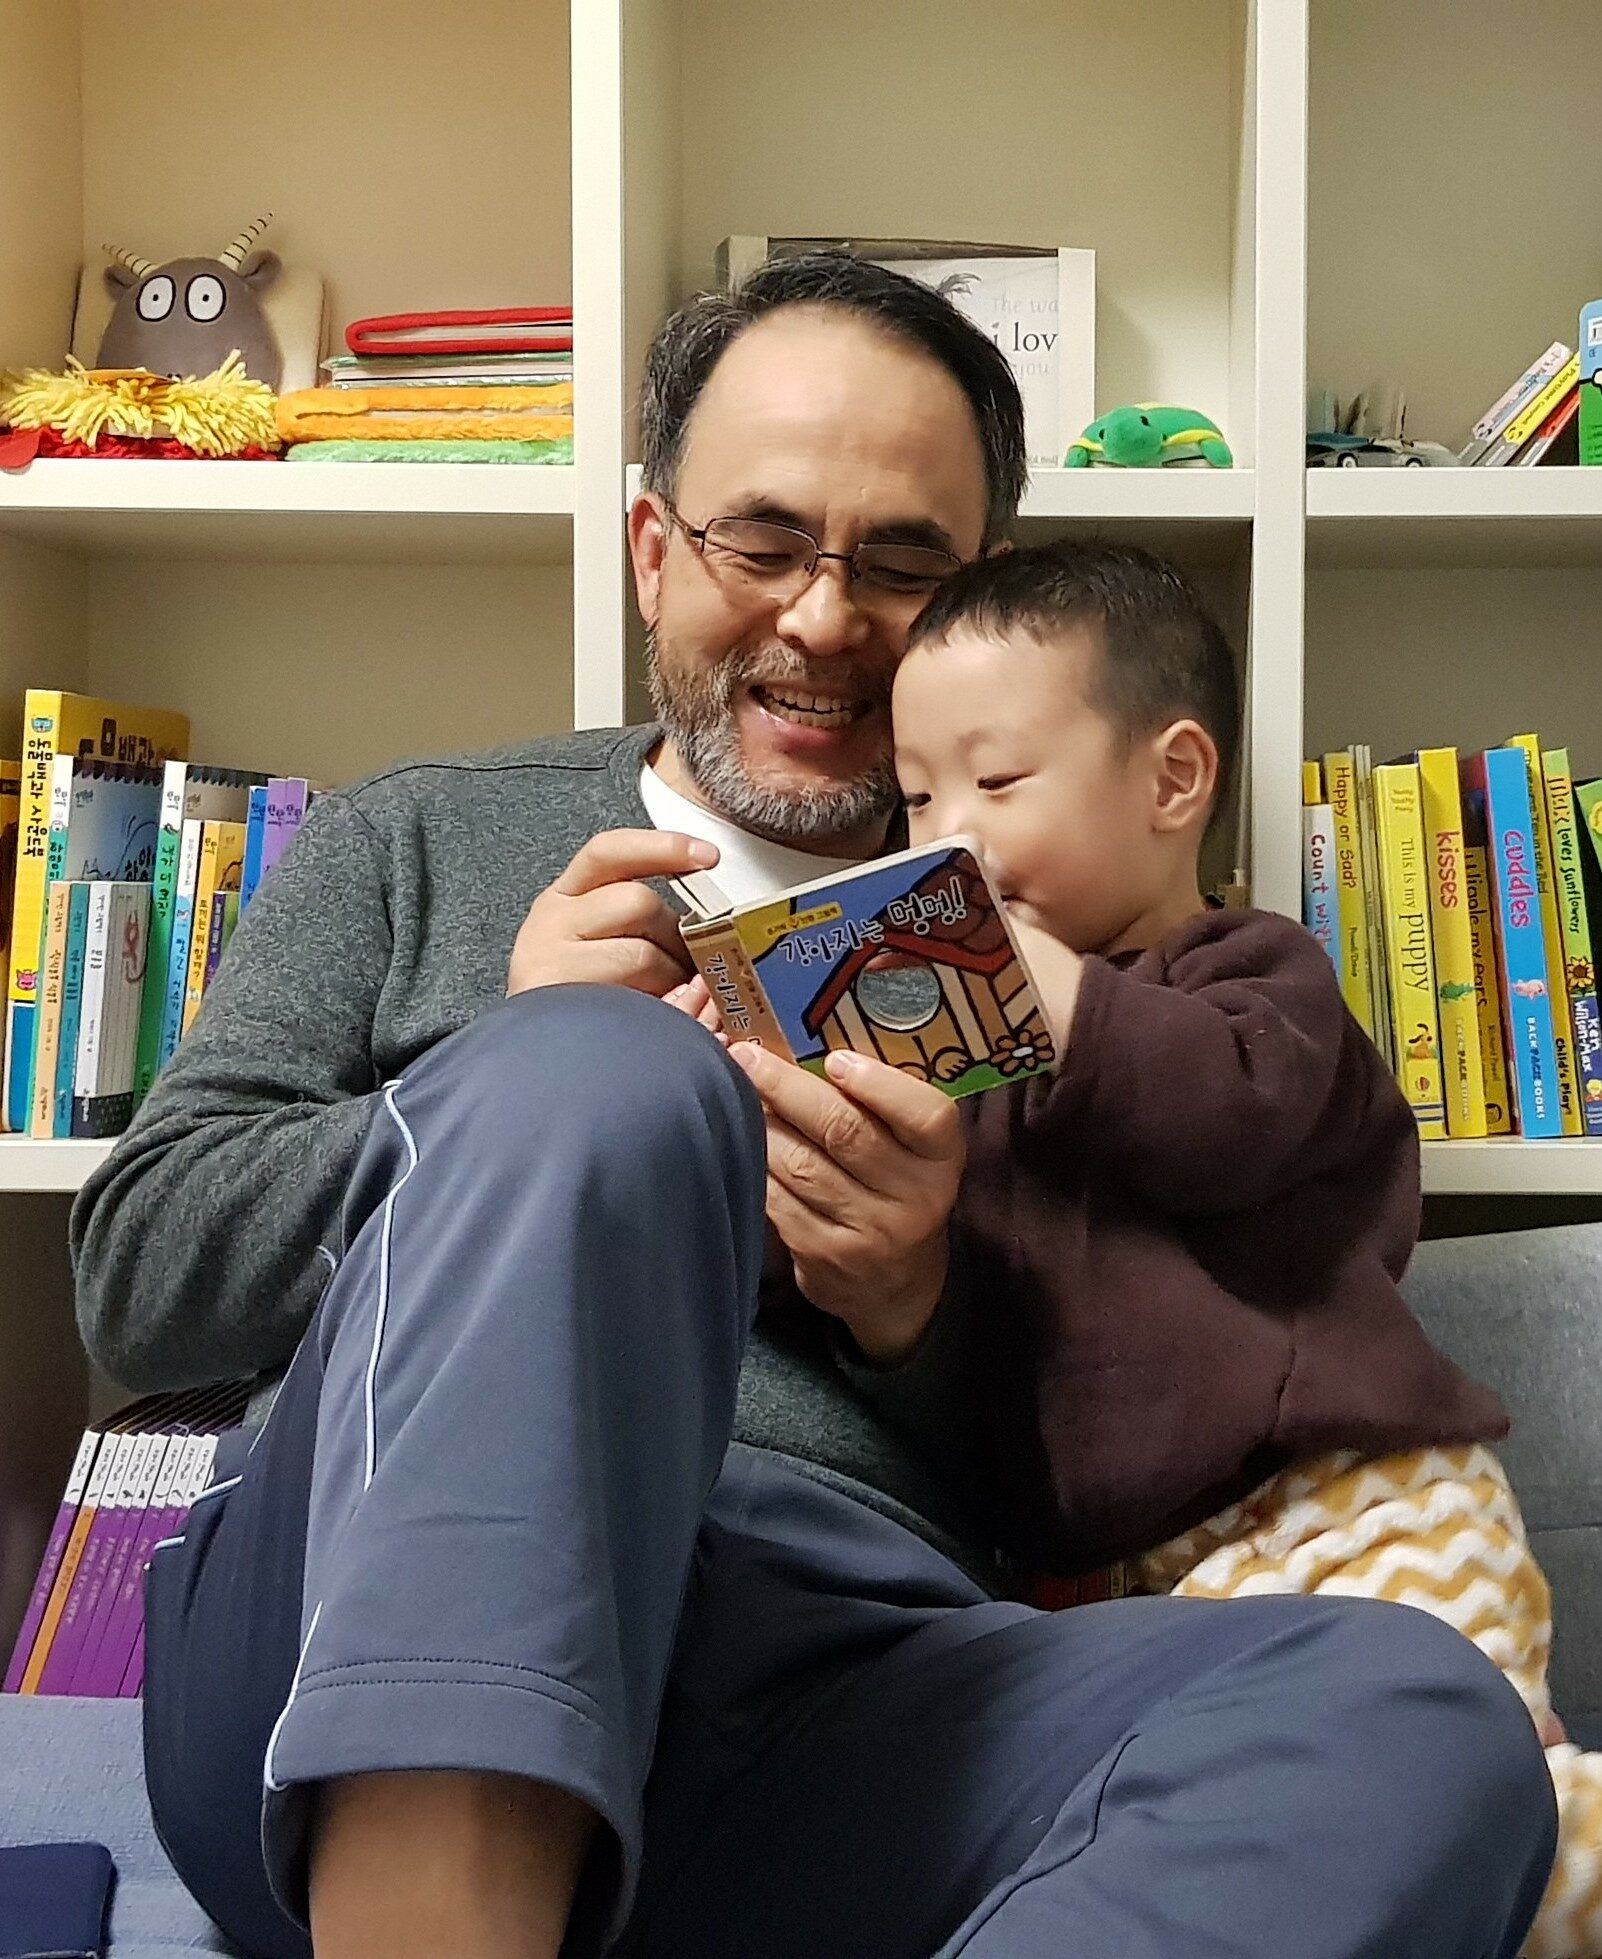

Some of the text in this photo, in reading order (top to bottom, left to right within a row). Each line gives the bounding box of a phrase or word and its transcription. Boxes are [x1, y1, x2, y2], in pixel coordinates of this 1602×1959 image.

[25, 738, 53, 857] 동물백과 사운드북
[1334, 766, 1356, 889] Happy or Sad?
[1311, 834, 1329, 894] Count
[1436, 831, 1460, 910] kisses
[1557, 828, 1572, 862] loves
[777, 919, 886, 966] 강아지는
[887, 875, 968, 935] 멍멍!
[1399, 838, 1429, 992] This is my puppy
[704, 951, 751, 1032] 강아지는
[1574, 1000, 1592, 1073] Wilson-Max
[1587, 1017, 1600, 1051] Ken
